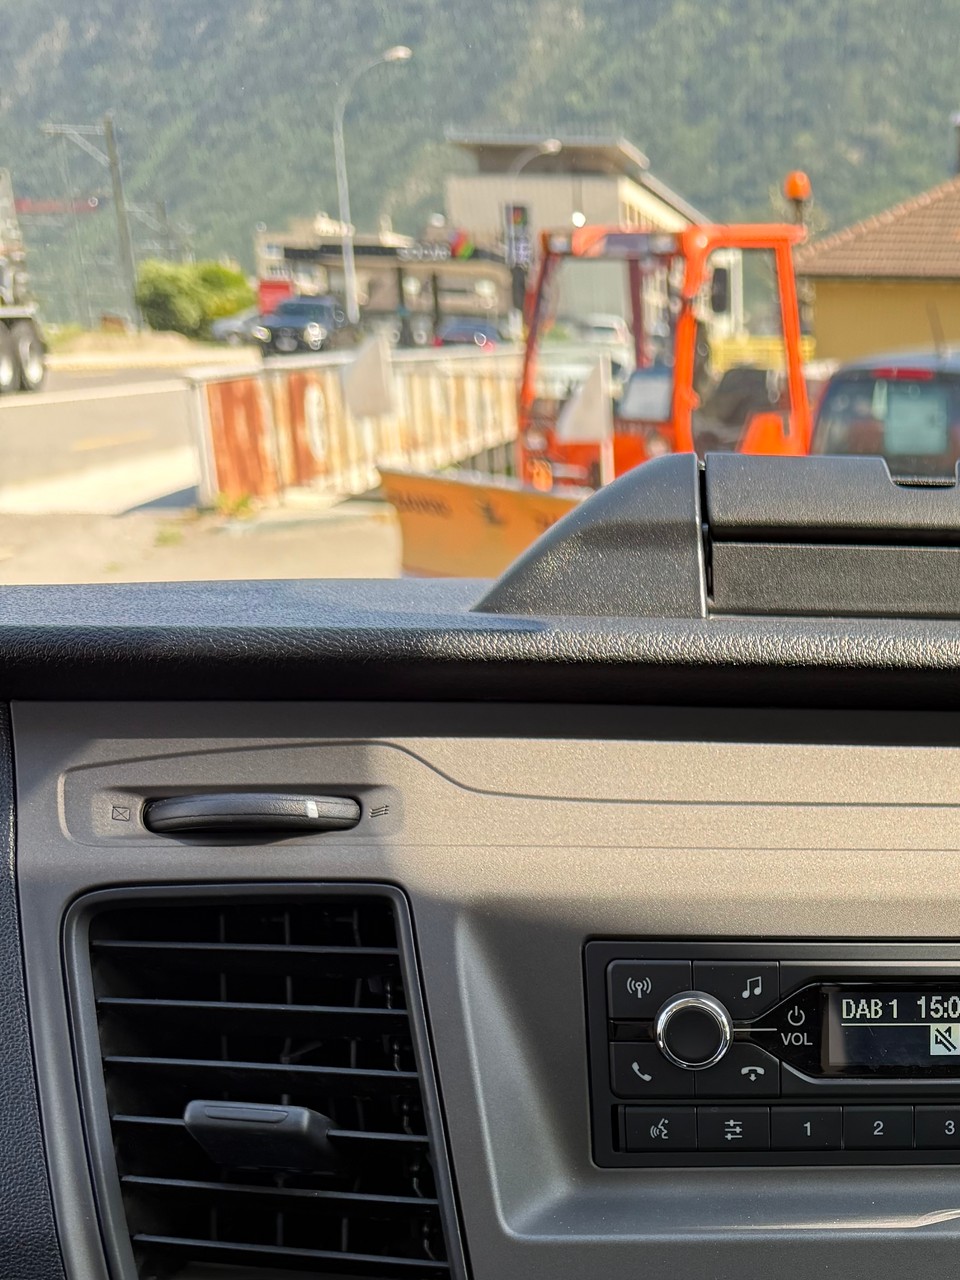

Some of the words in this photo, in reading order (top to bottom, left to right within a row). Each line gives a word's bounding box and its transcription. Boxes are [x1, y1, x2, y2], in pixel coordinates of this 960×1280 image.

[841, 998, 883, 1019] DAB
[889, 998, 898, 1019] 1
[780, 1032, 813, 1046] VOL
[803, 1121, 812, 1137] 1
[873, 1120, 884, 1136] 2
[944, 1120, 956, 1135] 3
